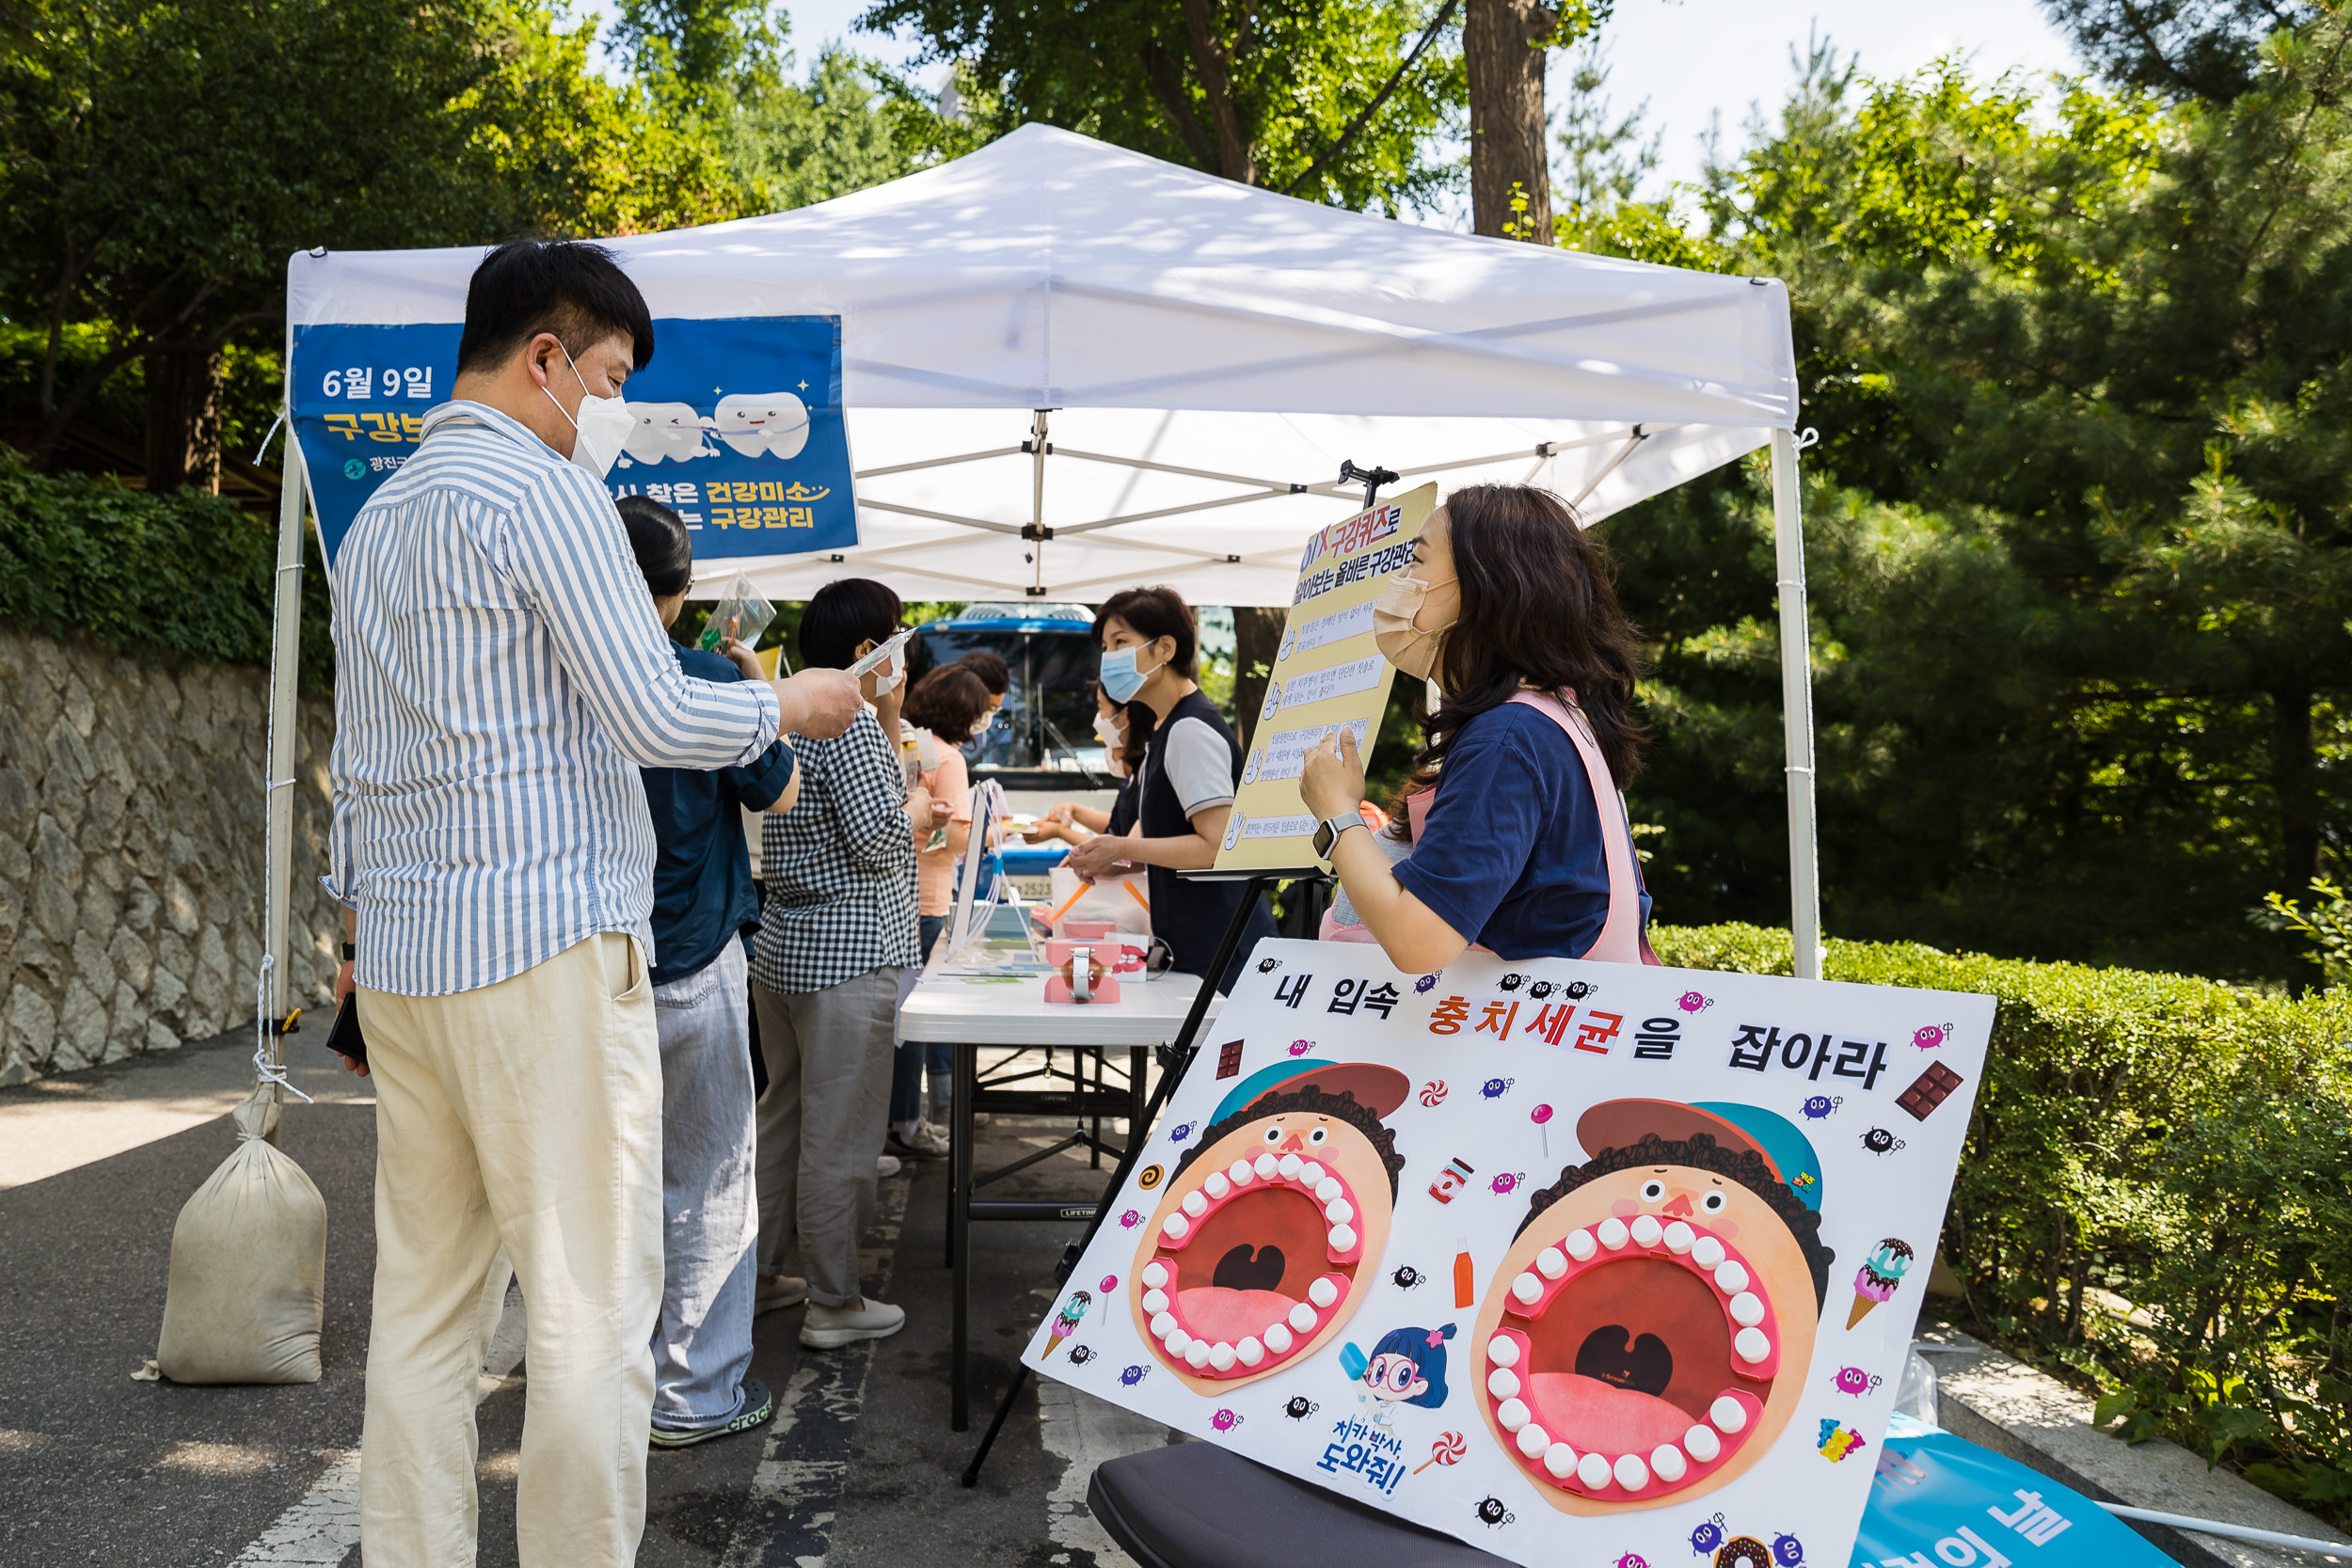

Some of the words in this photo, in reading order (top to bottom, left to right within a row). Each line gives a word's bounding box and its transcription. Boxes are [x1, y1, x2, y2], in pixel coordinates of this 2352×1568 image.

[323, 367, 373, 399] 6월
[382, 366, 432, 399] 9일
[645, 483, 699, 504] 찾은
[706, 481, 831, 503] 건강미소
[710, 507, 814, 530] 구강관리
[1331, 504, 1401, 560] 구강퀴즈로
[1294, 567, 1334, 607] 알아보는
[1334, 553, 1370, 588] 올바른
[1320, 669, 1337, 684] 있으면
[1338, 664, 1356, 680] 단단한
[1358, 660, 1375, 674] 칫솔로
[1274, 974, 1313, 1009] 내
[1326, 978, 1400, 1021] 입속
[1729, 1023, 1888, 1090] 잡아라
[1332, 1414, 1369, 1444] 치카
[1316, 1443, 1406, 1496] 도와줘!
[1986, 1488, 2074, 1548] 날
